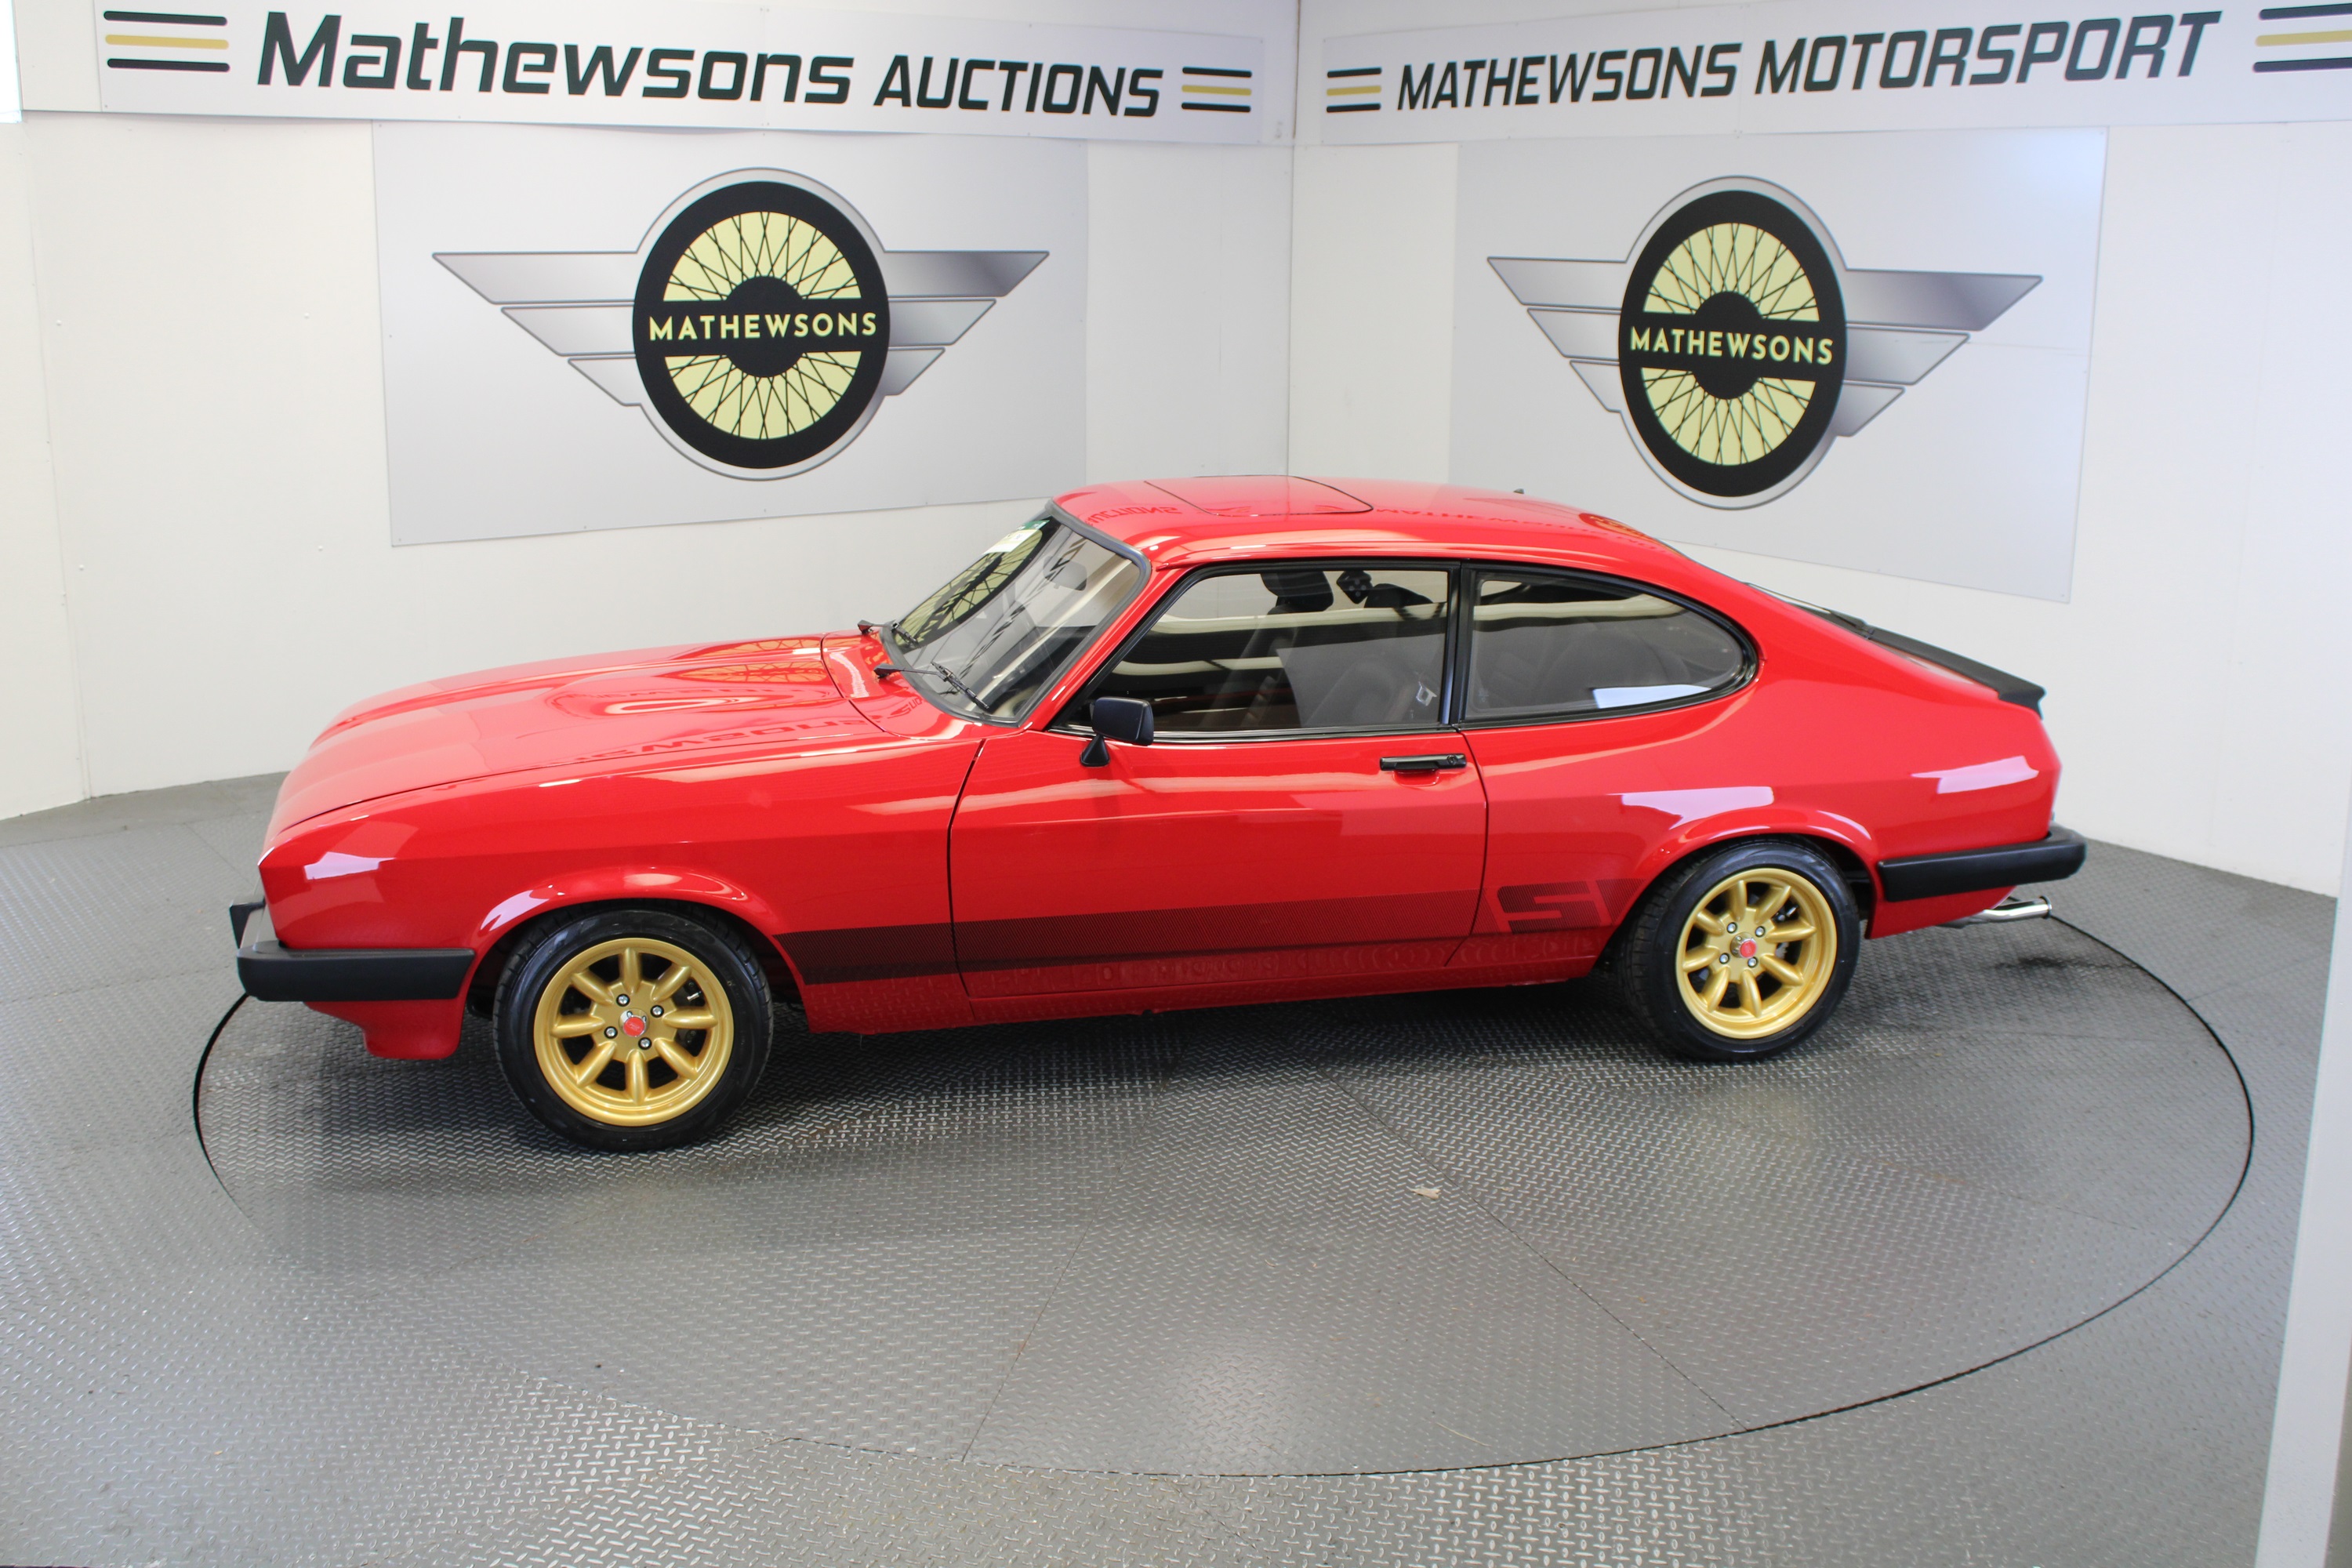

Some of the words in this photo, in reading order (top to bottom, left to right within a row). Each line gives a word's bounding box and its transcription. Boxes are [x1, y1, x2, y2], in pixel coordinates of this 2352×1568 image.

[257, 11, 854, 104] Mathewsons
[873, 54, 1163, 118] AUCTIONS
[1396, 42, 1743, 111] MATHEWSONS
[1754, 10, 2223, 95] MOTORSPORT
[649, 312, 877, 341] MATHEWSONS
[1630, 326, 1834, 365] MATHEWSONS
